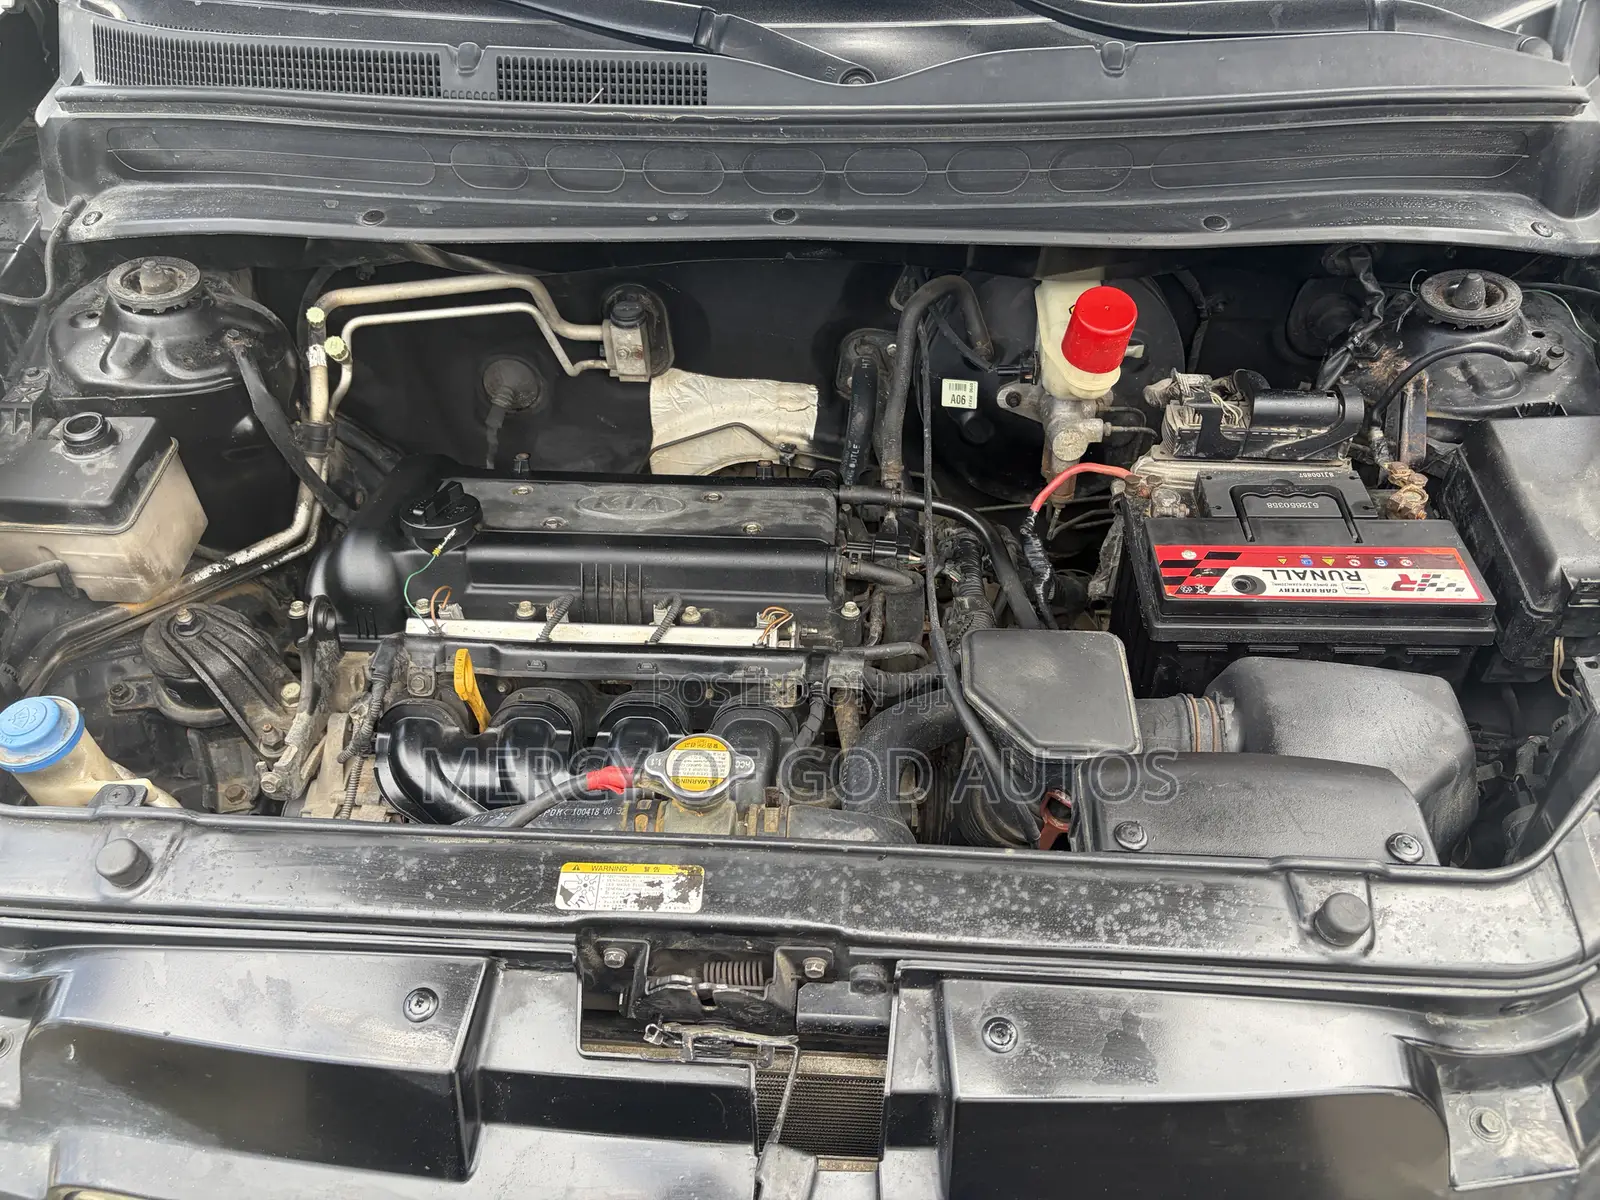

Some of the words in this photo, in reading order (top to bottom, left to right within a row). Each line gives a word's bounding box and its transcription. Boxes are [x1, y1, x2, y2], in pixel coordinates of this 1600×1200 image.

[950, 393, 967, 405] A06
[592, 495, 667, 513] KIA
[1262, 568, 1363, 582] RUNALL
[572, 807, 600, 816] 100418
